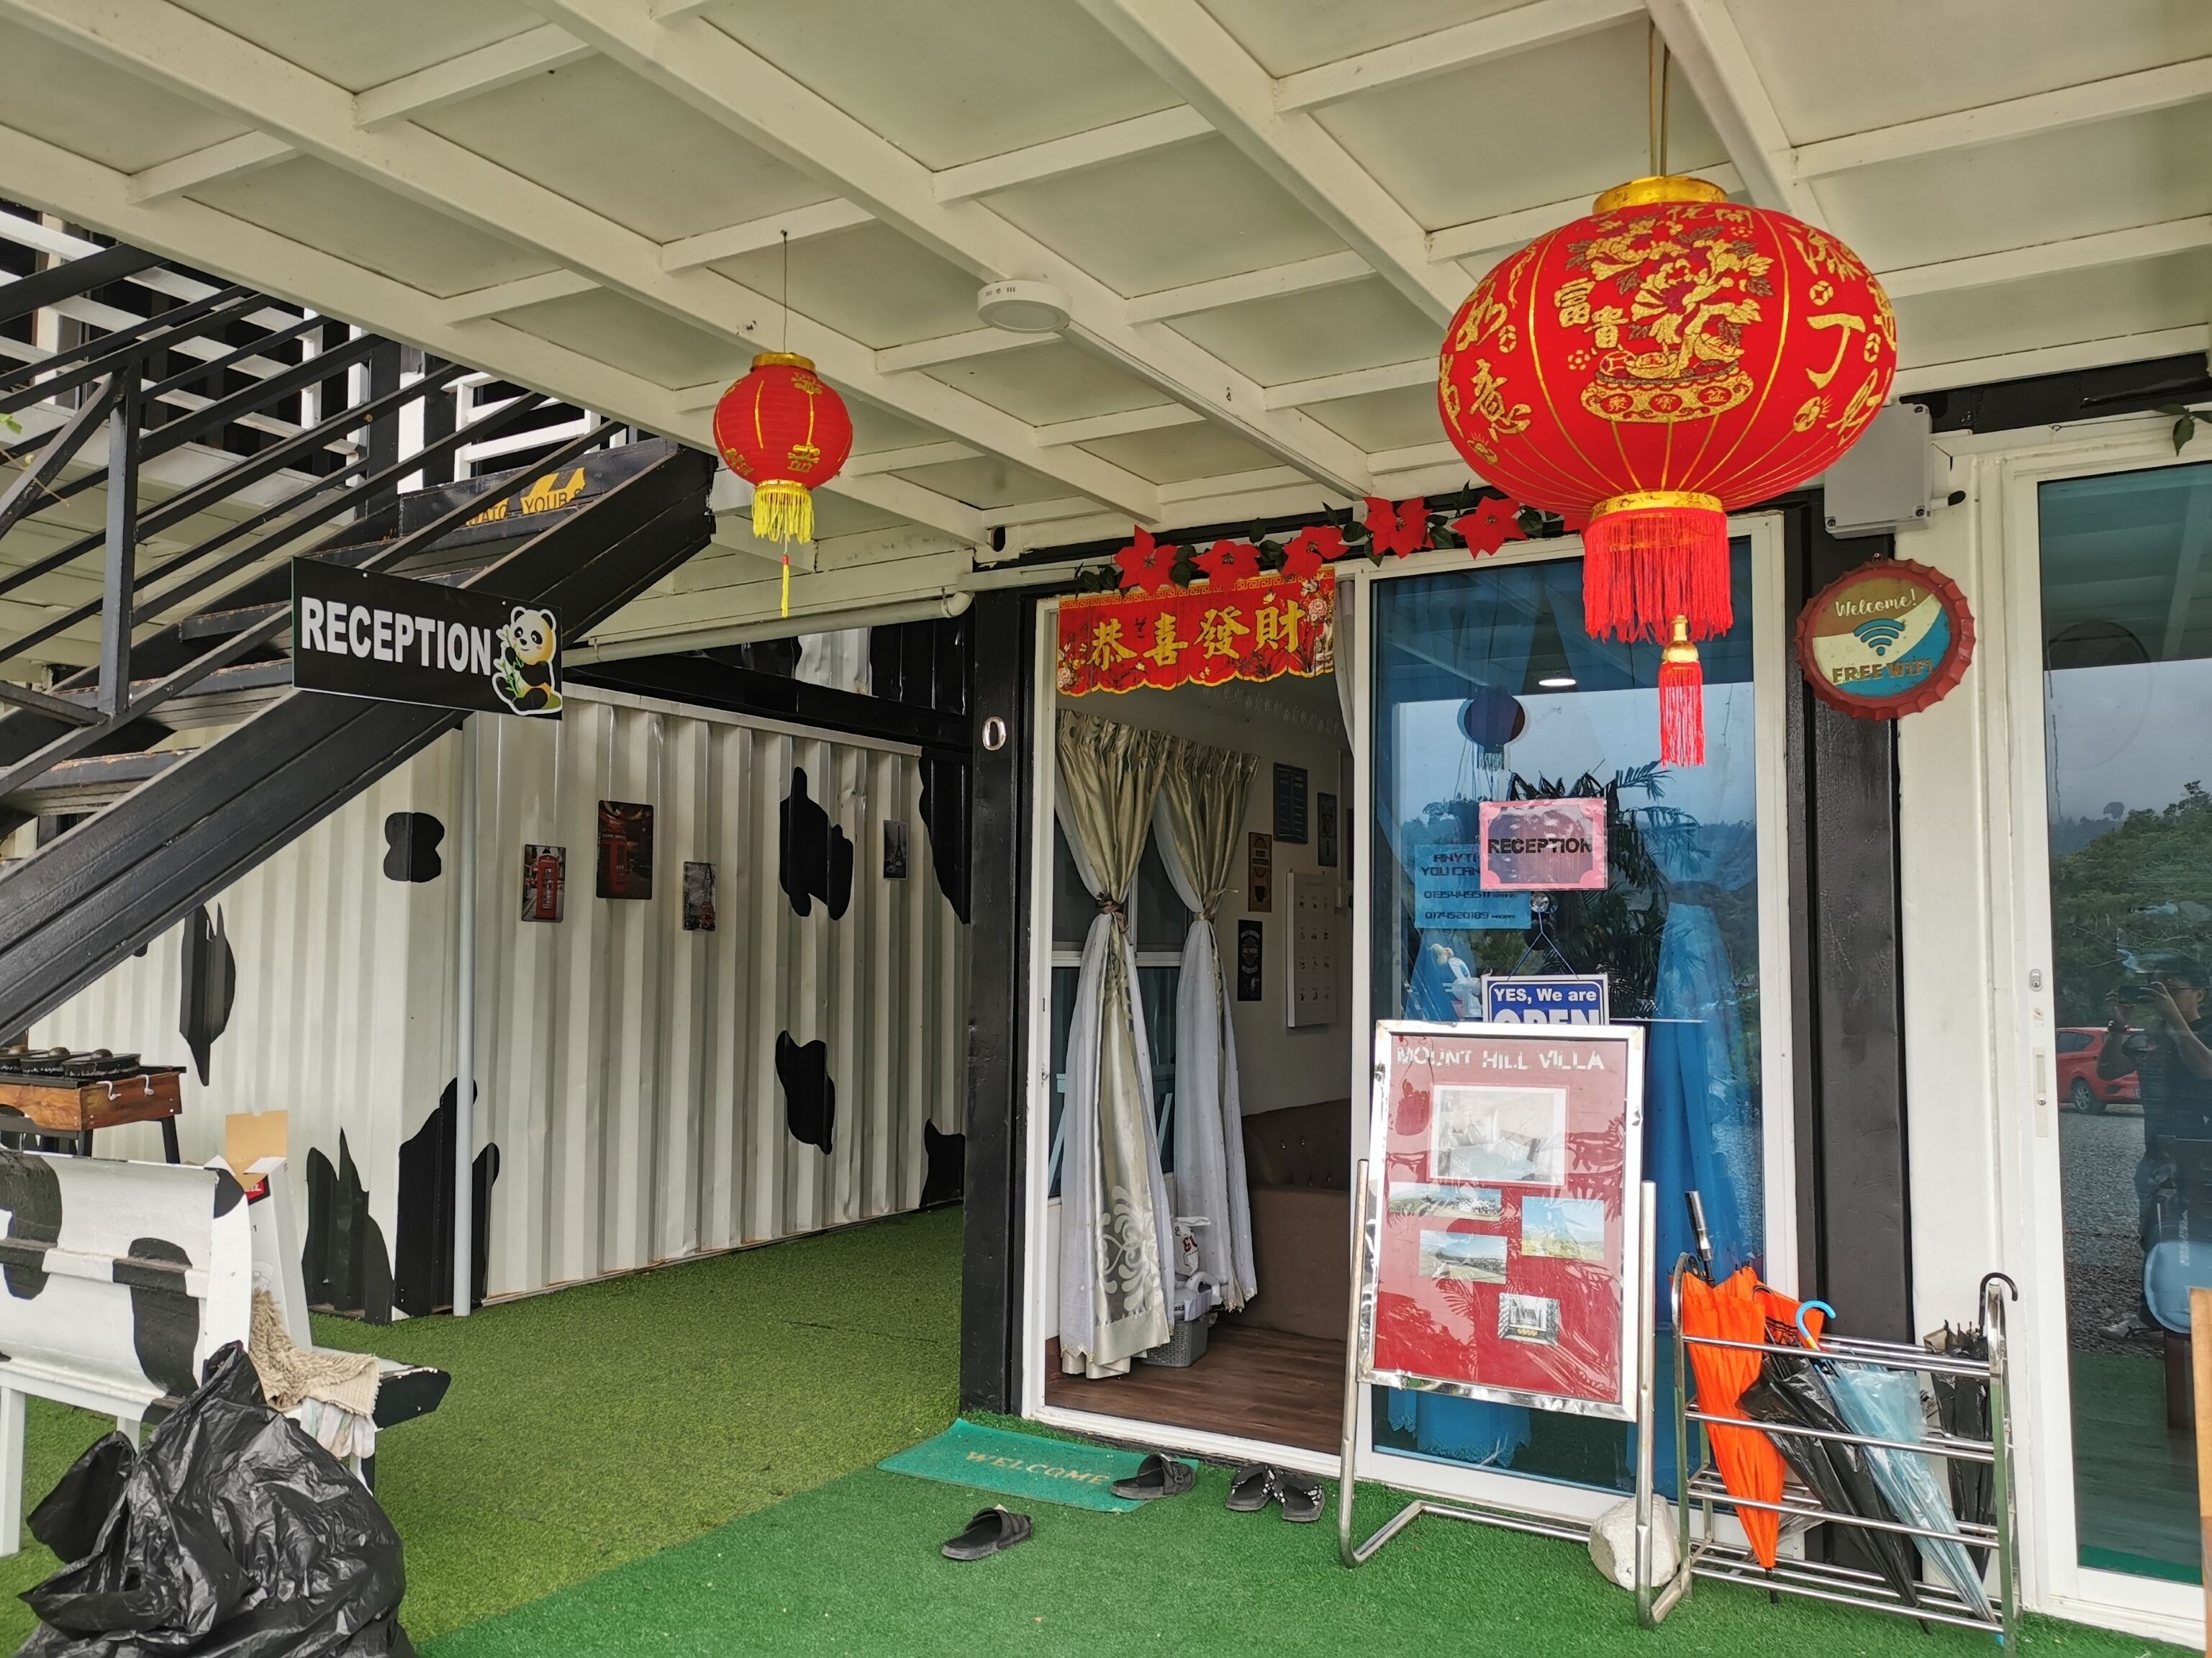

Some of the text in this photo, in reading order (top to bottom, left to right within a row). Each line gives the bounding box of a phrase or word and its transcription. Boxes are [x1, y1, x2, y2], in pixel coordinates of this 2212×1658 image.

[1554, 277, 1628, 348] 富貴
[468, 491, 567, 526] WATC YOUR
[1836, 588, 1917, 617] Welcome!
[301, 596, 491, 676] RECEPTION
[1086, 599, 1306, 671] 恭喜發財
[1832, 663, 1884, 684] FREE
[1433, 852, 1480, 864] ANYTH
[1487, 838, 1592, 854] RECEPTION
[1420, 866, 1450, 876] YOU
[1493, 987, 1597, 1005] YES, We are
[1397, 1046, 1605, 1071] MOUNT HILL VILLA
[966, 1450, 1111, 1485] WELCOME
